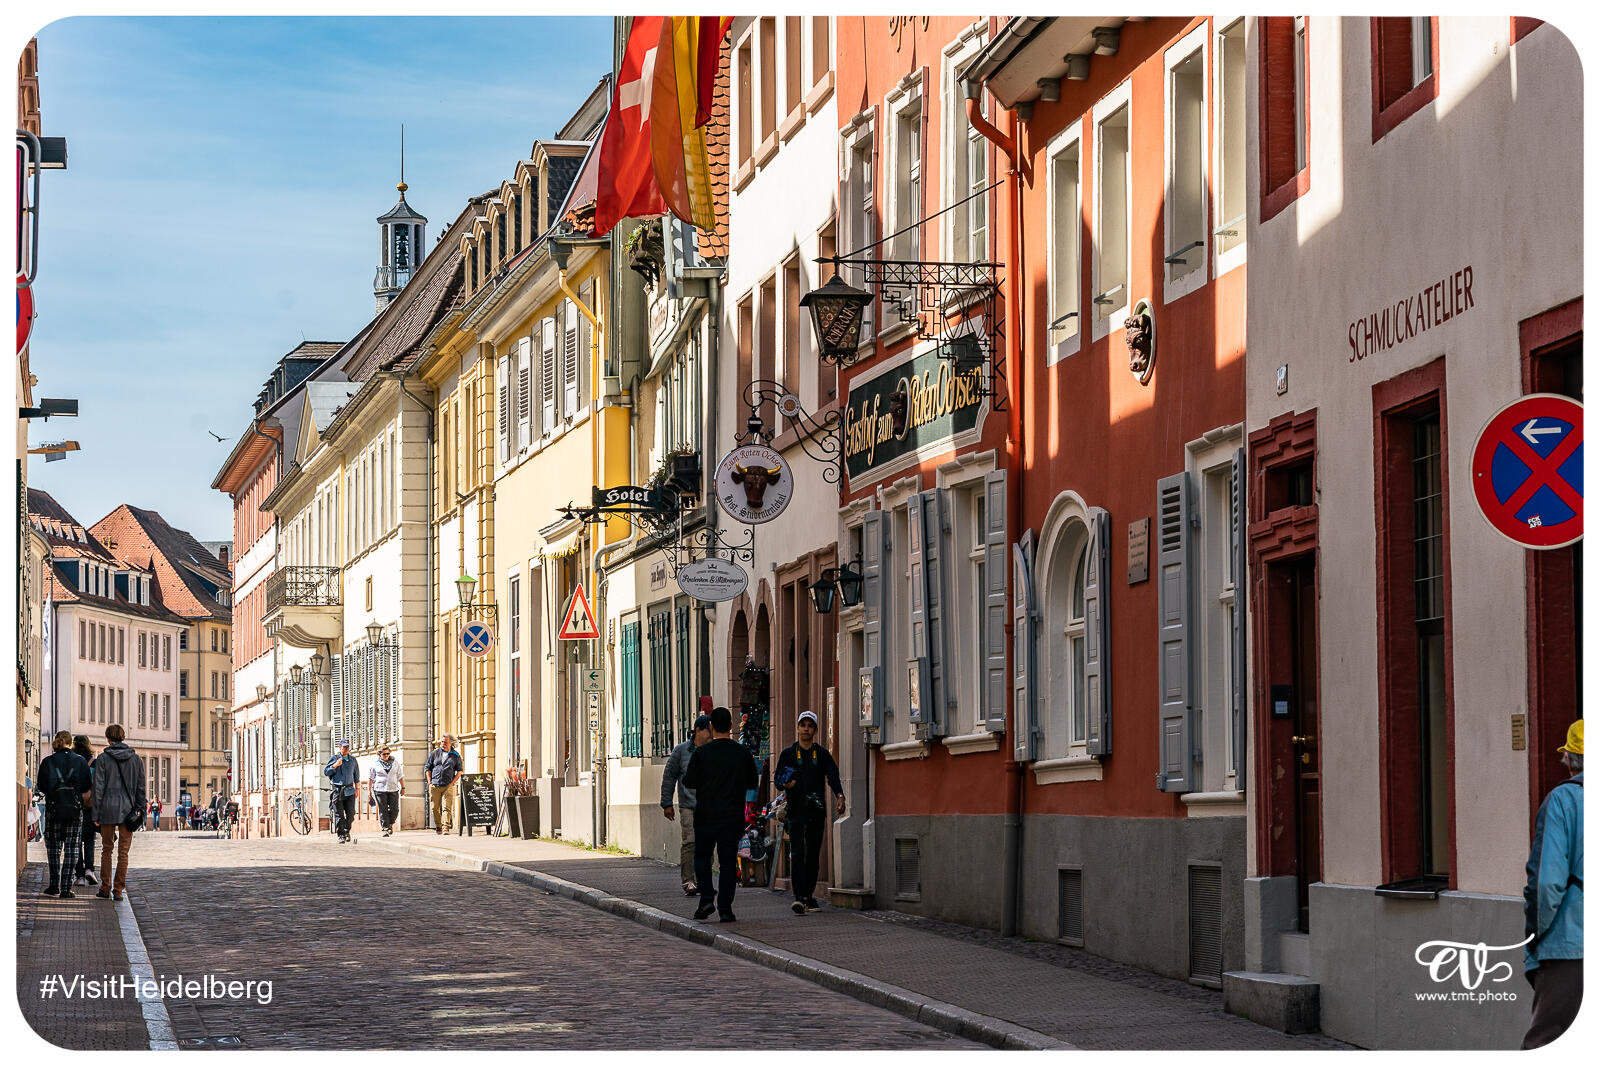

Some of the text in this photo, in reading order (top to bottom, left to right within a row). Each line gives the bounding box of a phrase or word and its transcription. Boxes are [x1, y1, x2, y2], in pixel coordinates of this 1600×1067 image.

[1348, 265, 1475, 363] SCHMUCKATELIER
[846, 355, 983, 467] Gasthof zum Roten Ochsen
[723, 449, 783, 471] Zum Roten Ochse
[605, 488, 649, 504] Hotel
[739, 493, 787, 520] Studentenlokal
[709, 575, 716, 584] &
